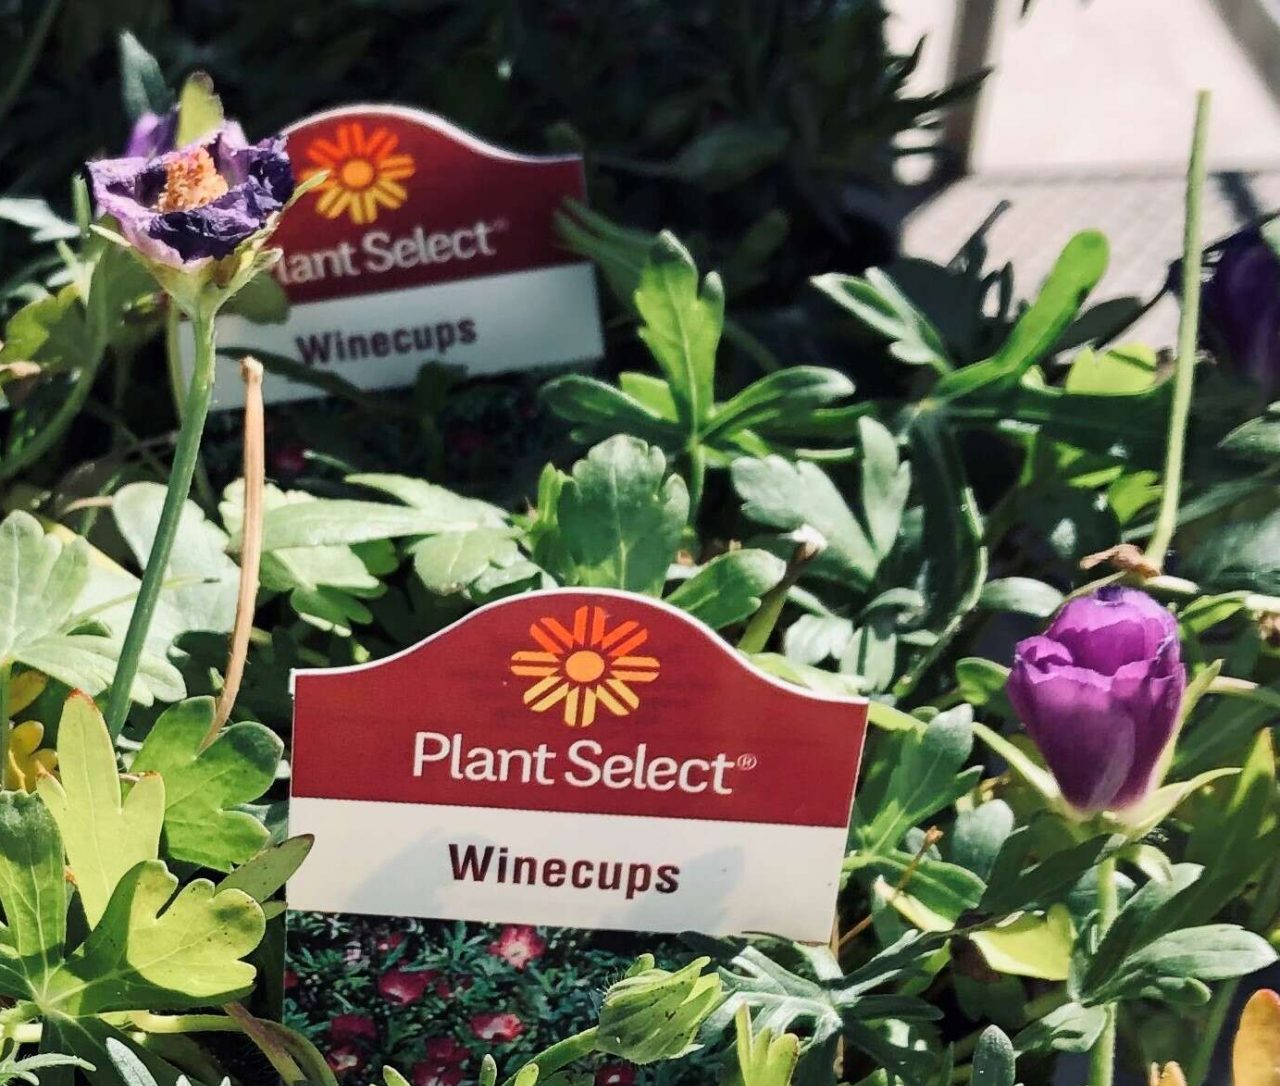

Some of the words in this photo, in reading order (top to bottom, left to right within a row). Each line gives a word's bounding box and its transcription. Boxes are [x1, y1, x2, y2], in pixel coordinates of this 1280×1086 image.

[277, 241, 361, 285] lant
[295, 318, 477, 366] Winecups
[413, 731, 557, 787] Plant
[448, 843, 681, 899] Winecups
